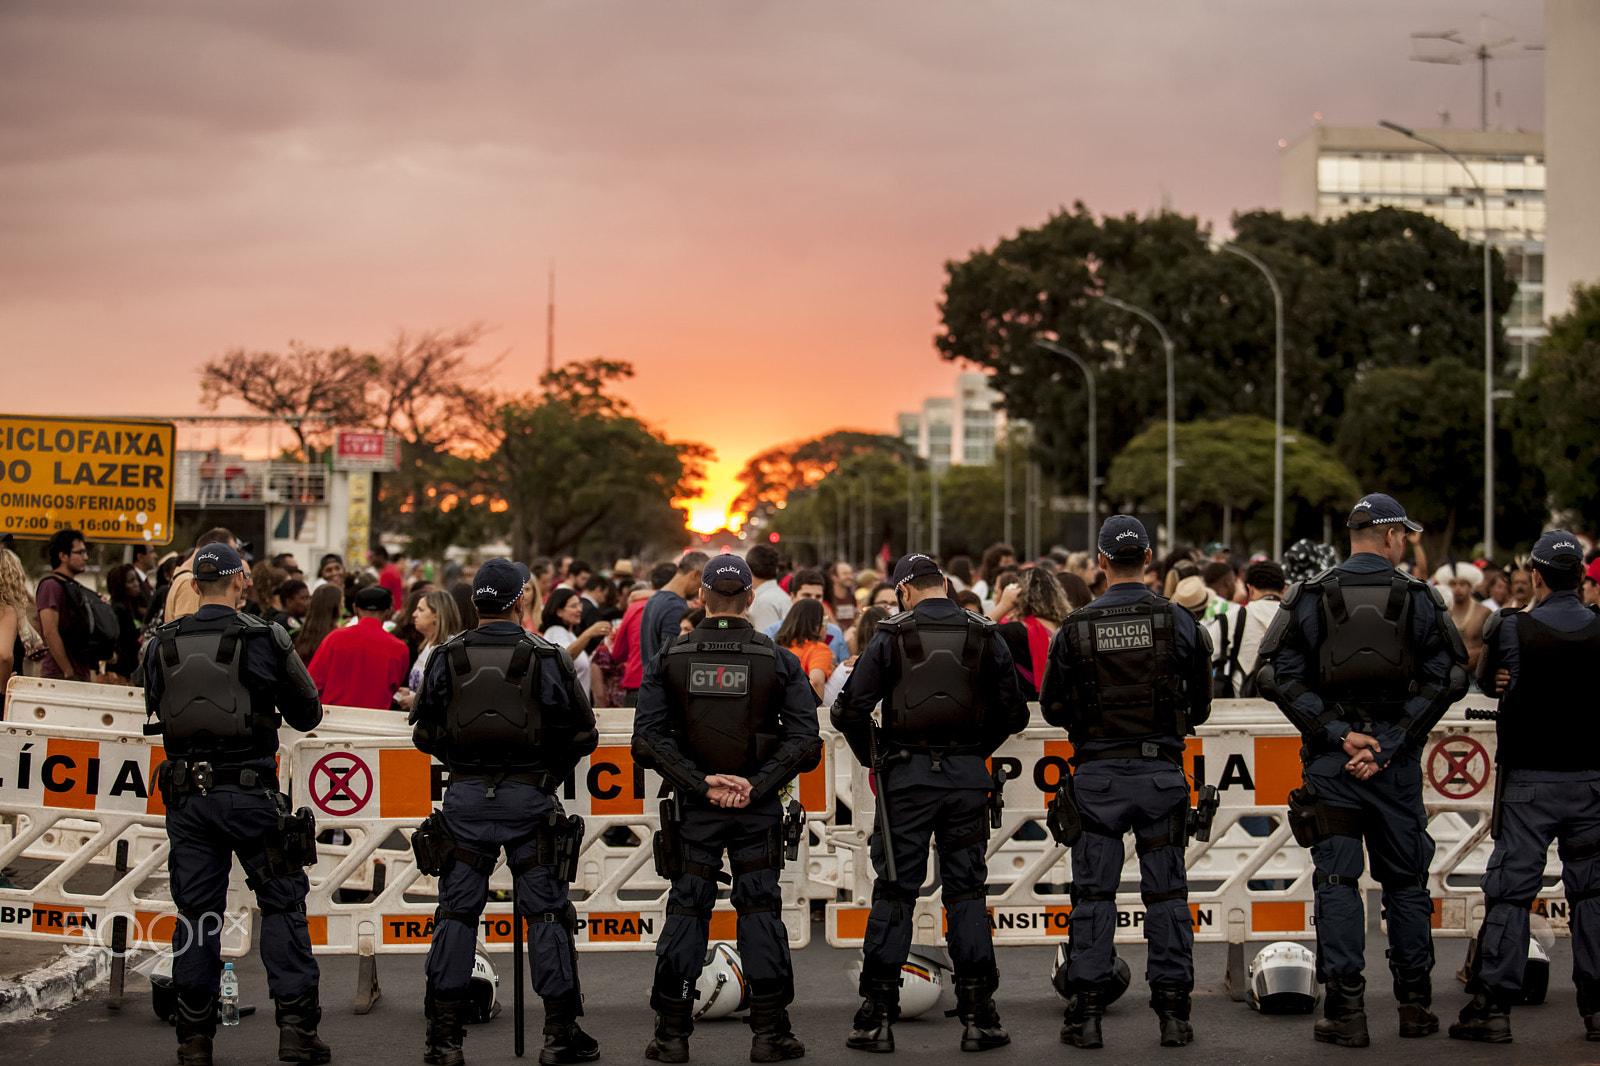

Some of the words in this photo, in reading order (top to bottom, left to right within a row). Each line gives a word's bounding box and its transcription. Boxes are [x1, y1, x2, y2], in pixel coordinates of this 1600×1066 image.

[0, 427, 164, 456] ICLOFAIXA
[0, 459, 32, 484] O
[53, 461, 164, 489] LAZER
[1, 493, 157, 512] OMINGOS/FERIADOS
[5, 516, 48, 529] 07:00
[78, 519, 121, 531] 16:00
[126, 521, 144, 532] hs
[1115, 529, 1139, 542] POLÍCIA
[1552, 540, 1575, 550] POLÍCIA
[198, 552, 220, 562] POLÍCIA
[716, 565, 741, 576] POLÍCIA
[476, 585, 498, 597] POLÍCIA
[1097, 624, 1149, 638] POLÍCIA
[1098, 635, 1151, 649] MILITAR
[0, 743, 148, 799] ÍCIA
[1, 906, 97, 930] BPTRAN
[987, 909, 1070, 930] ÂNSITO
[574, 918, 653, 937] PTRAN
